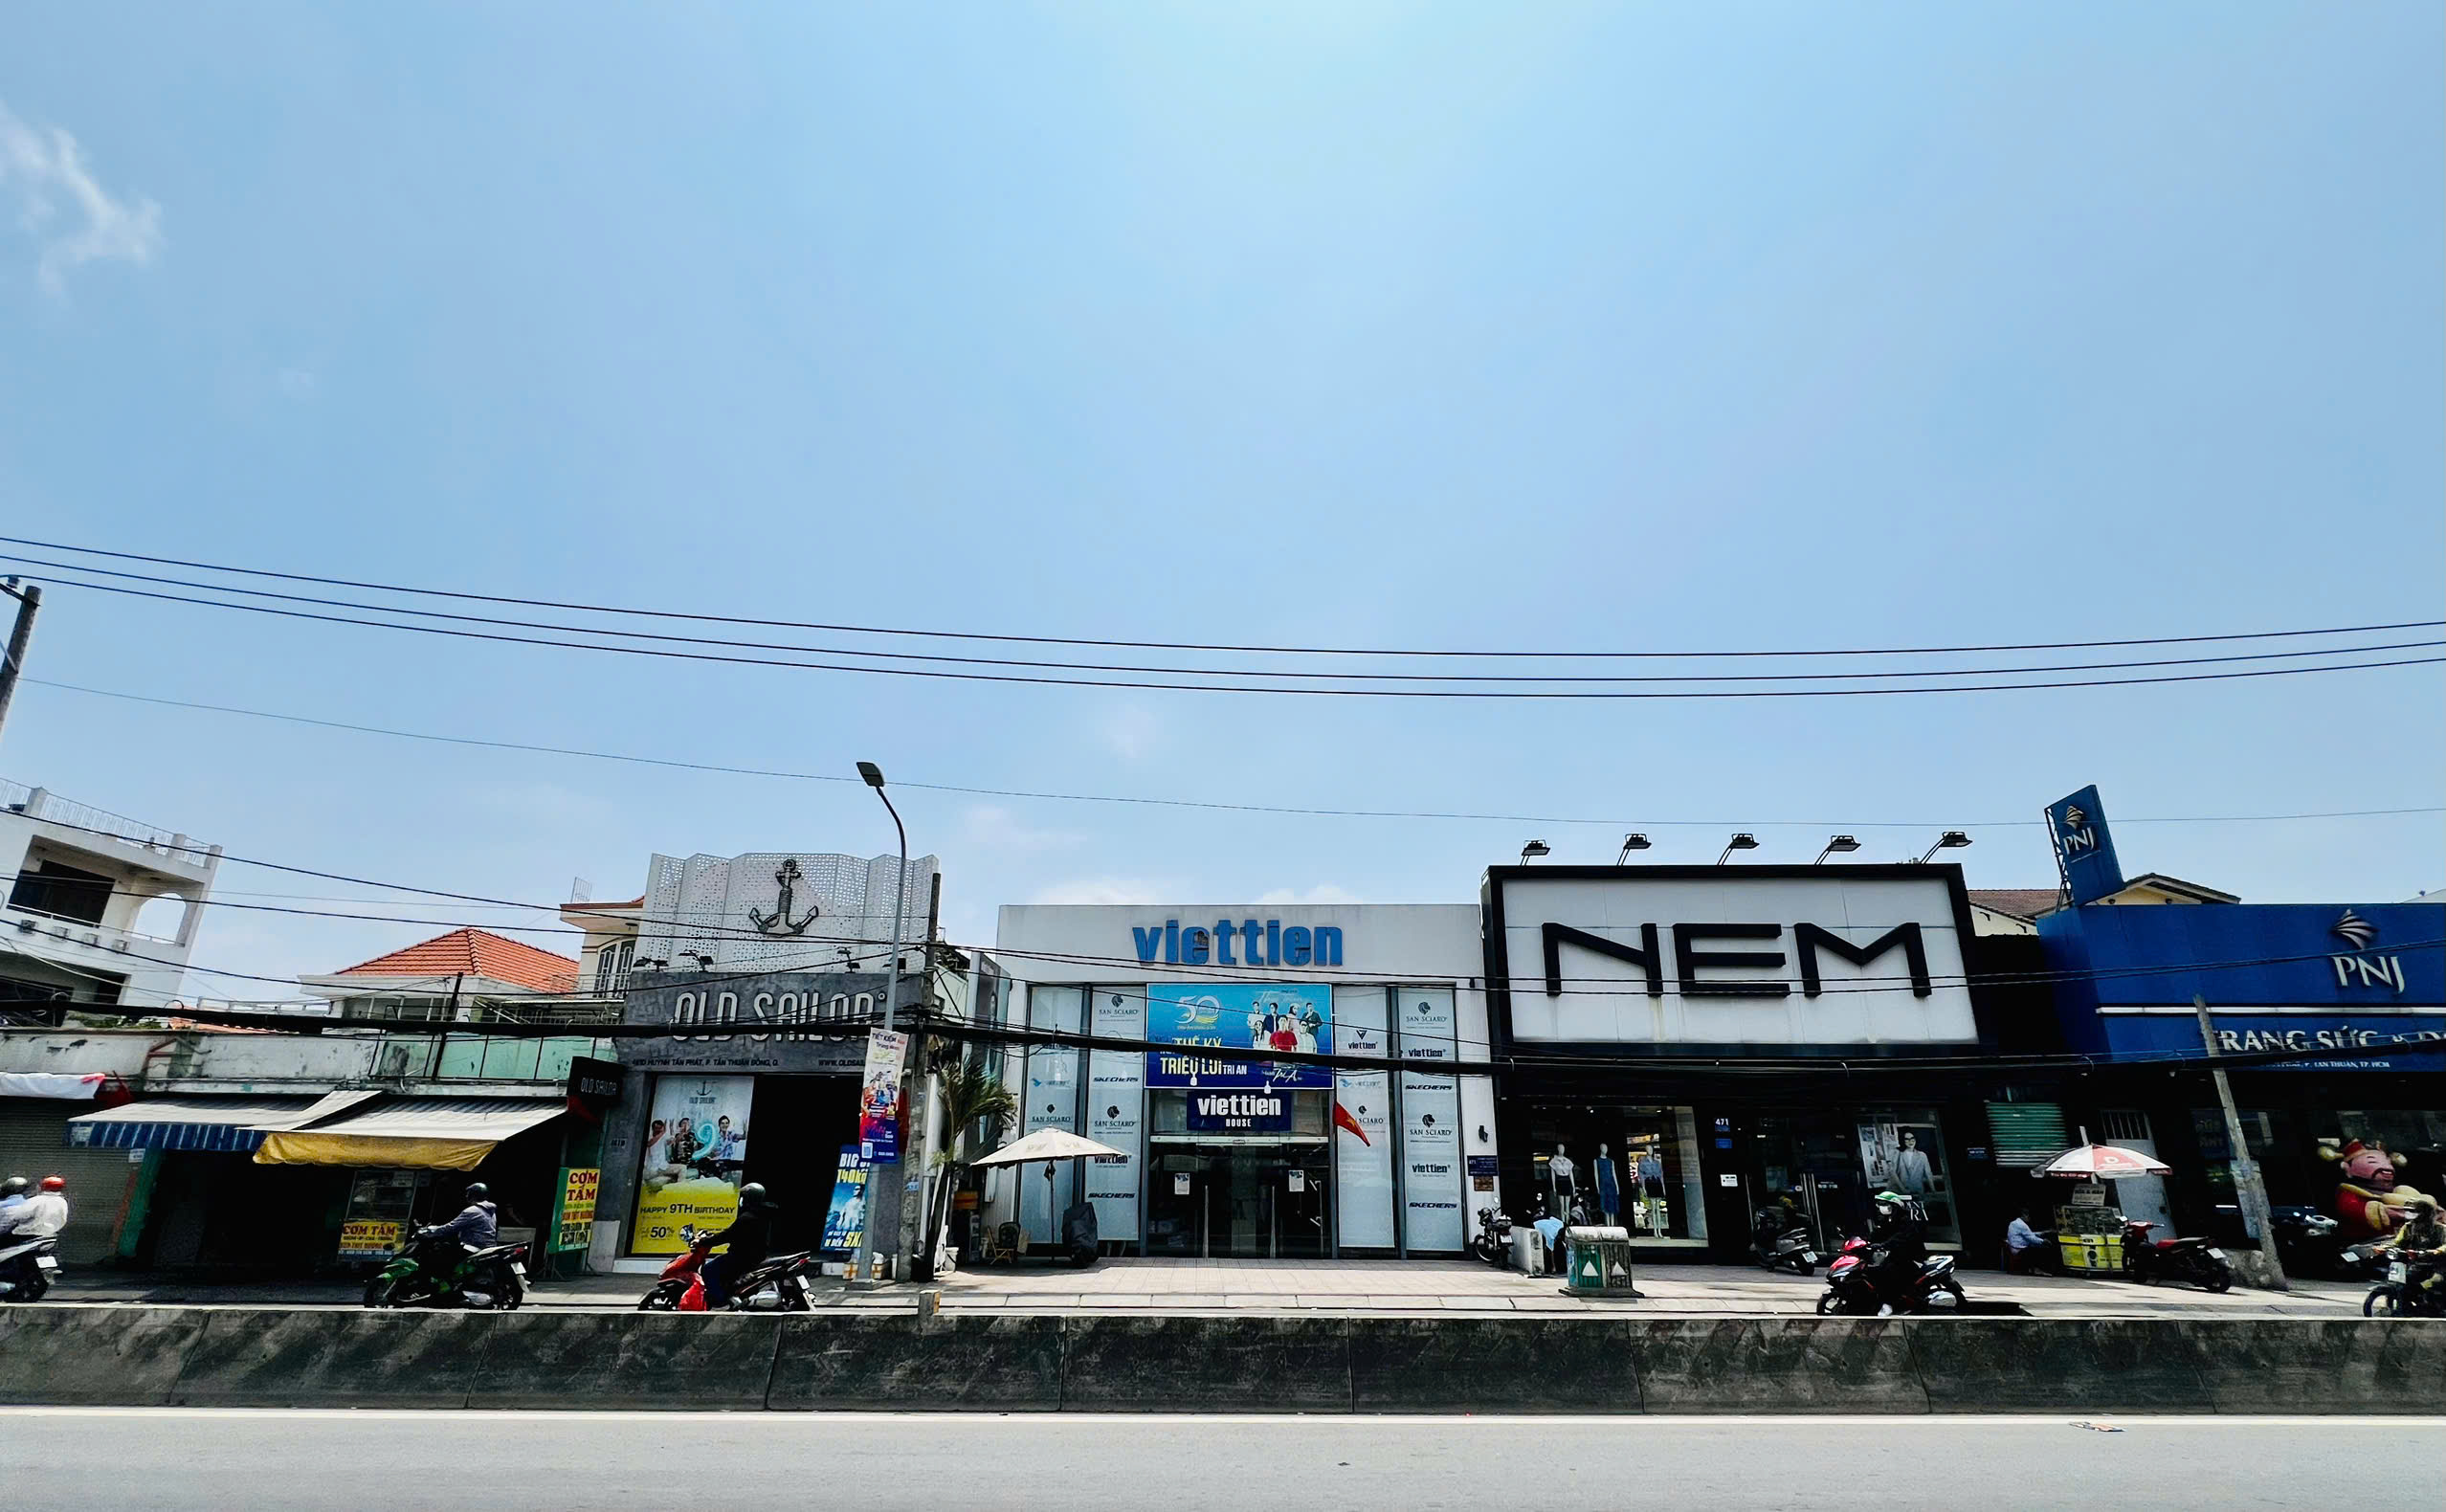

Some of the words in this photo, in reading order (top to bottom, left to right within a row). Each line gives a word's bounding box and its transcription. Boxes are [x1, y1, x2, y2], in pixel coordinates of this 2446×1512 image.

[2062, 827, 2095, 856] PNJ
[1132, 920, 1343, 967] viettien
[1542, 923, 1932, 997] NEM
[2331, 956, 2405, 993] PNJ
[672, 991, 738, 1041] OLD
[1347, 1041, 1377, 1050] viettien
[2212, 1030, 2308, 1052] RANG
[1408, 1048, 1443, 1057] viettien
[581, 1078, 593, 1093] OLD
[1197, 1095, 1281, 1116] viettien
[1225, 1118, 1252, 1127] HOUSE
[839, 1153, 859, 1167] BIG
[1412, 1164, 1448, 1173] viettien
[569, 1169, 598, 1184] CƠM
[669, 1204, 693, 1214] 9TH
